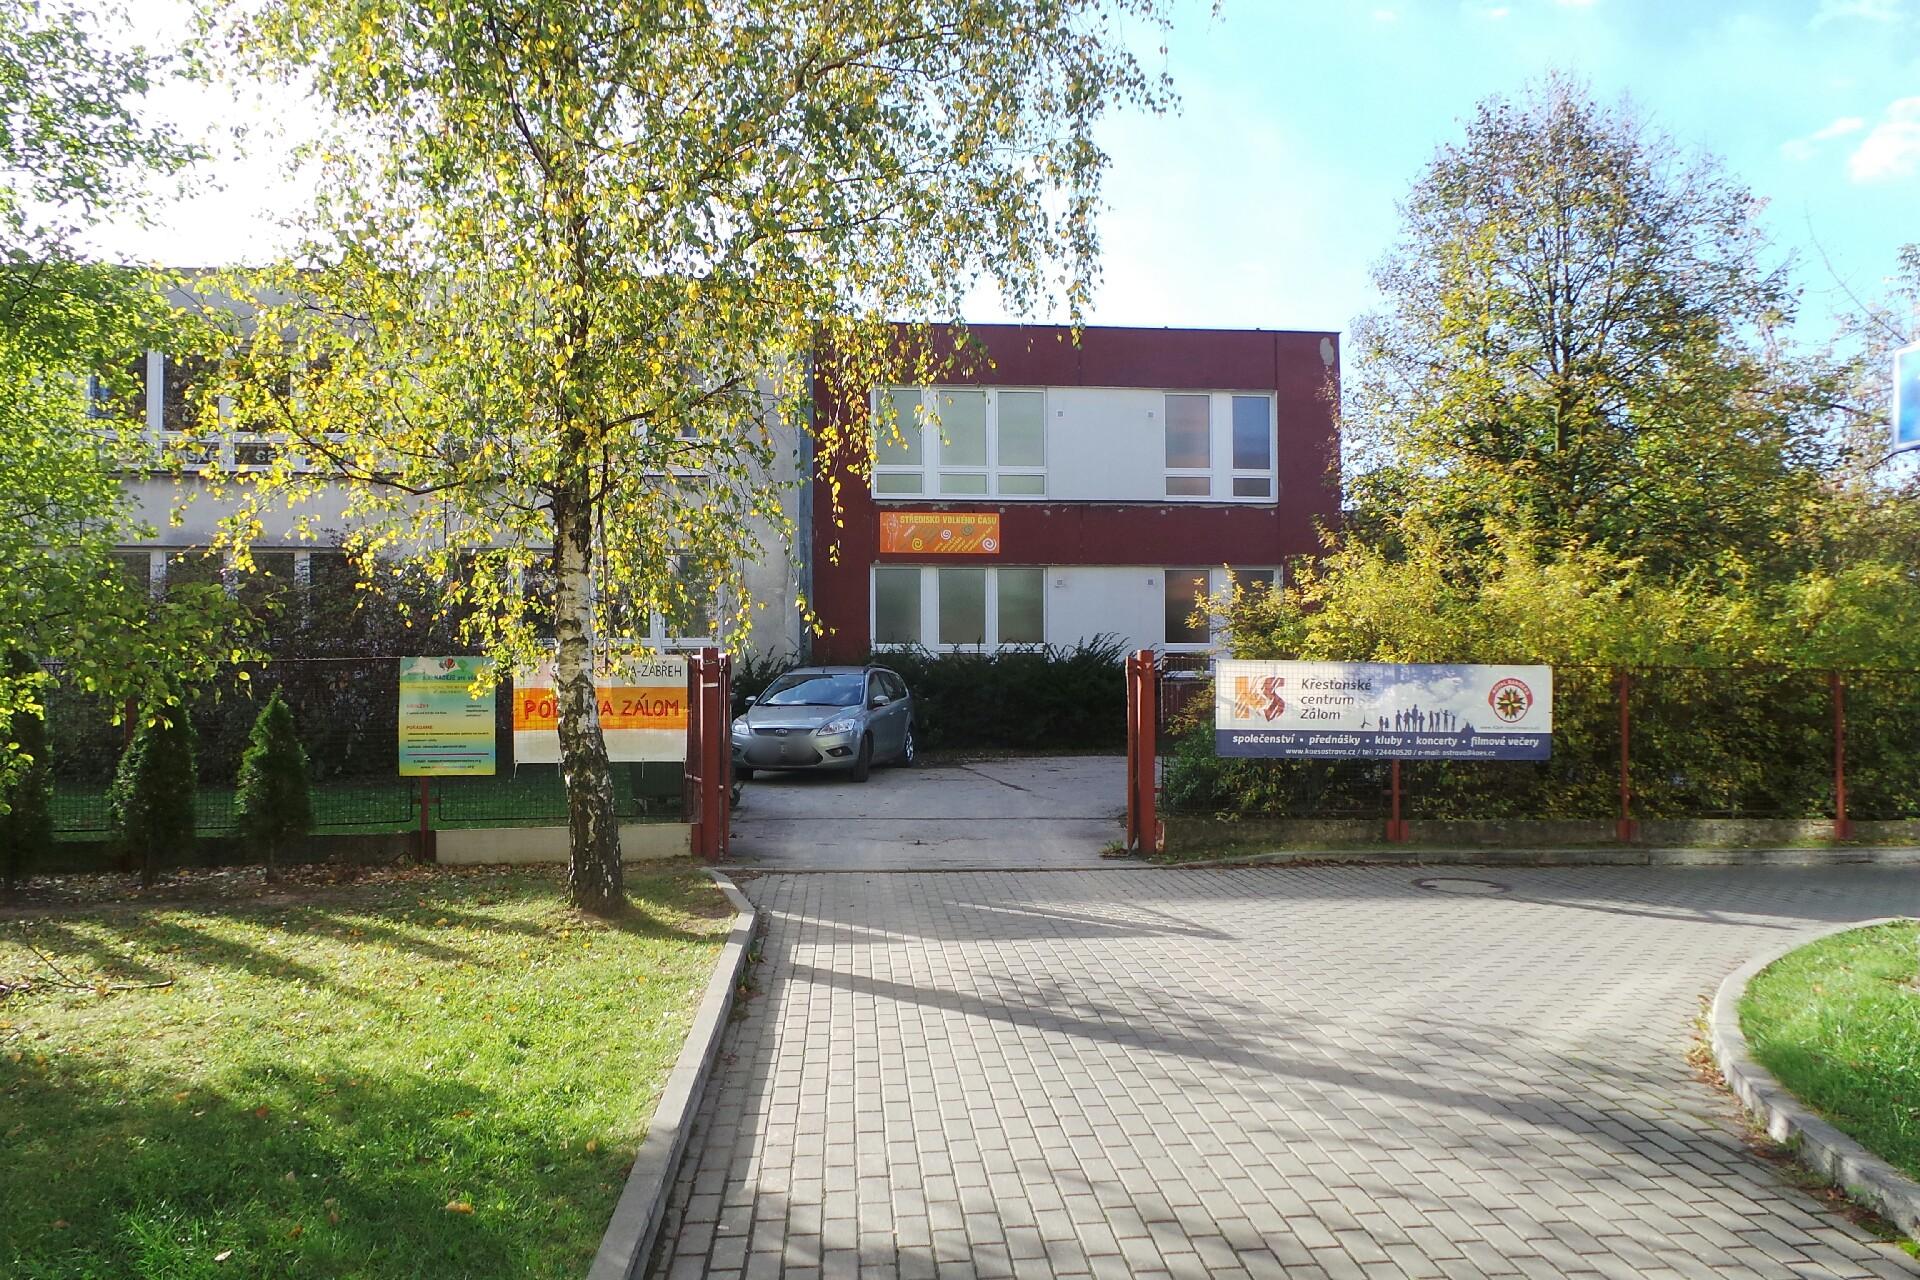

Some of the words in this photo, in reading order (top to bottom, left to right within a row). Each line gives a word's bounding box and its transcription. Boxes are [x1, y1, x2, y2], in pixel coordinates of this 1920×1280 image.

[900, 514, 940, 524] STŘEDISKO
[943, 514, 975, 524] VOLNÉHO
[977, 514, 997, 525] ČASU
[622, 693, 679, 716] ZÁLOM
[1300, 694, 1354, 705] centrum
[1300, 707, 1341, 720] Zálom
[1232, 733, 1295, 745] společenství
[1309, 735, 1360, 746] přednášky
[1374, 736, 1402, 747] kluby
[1416, 736, 1458, 747] koncerty
[1470, 736, 1506, 747] filmové
[1508, 736, 1539, 748] večery
